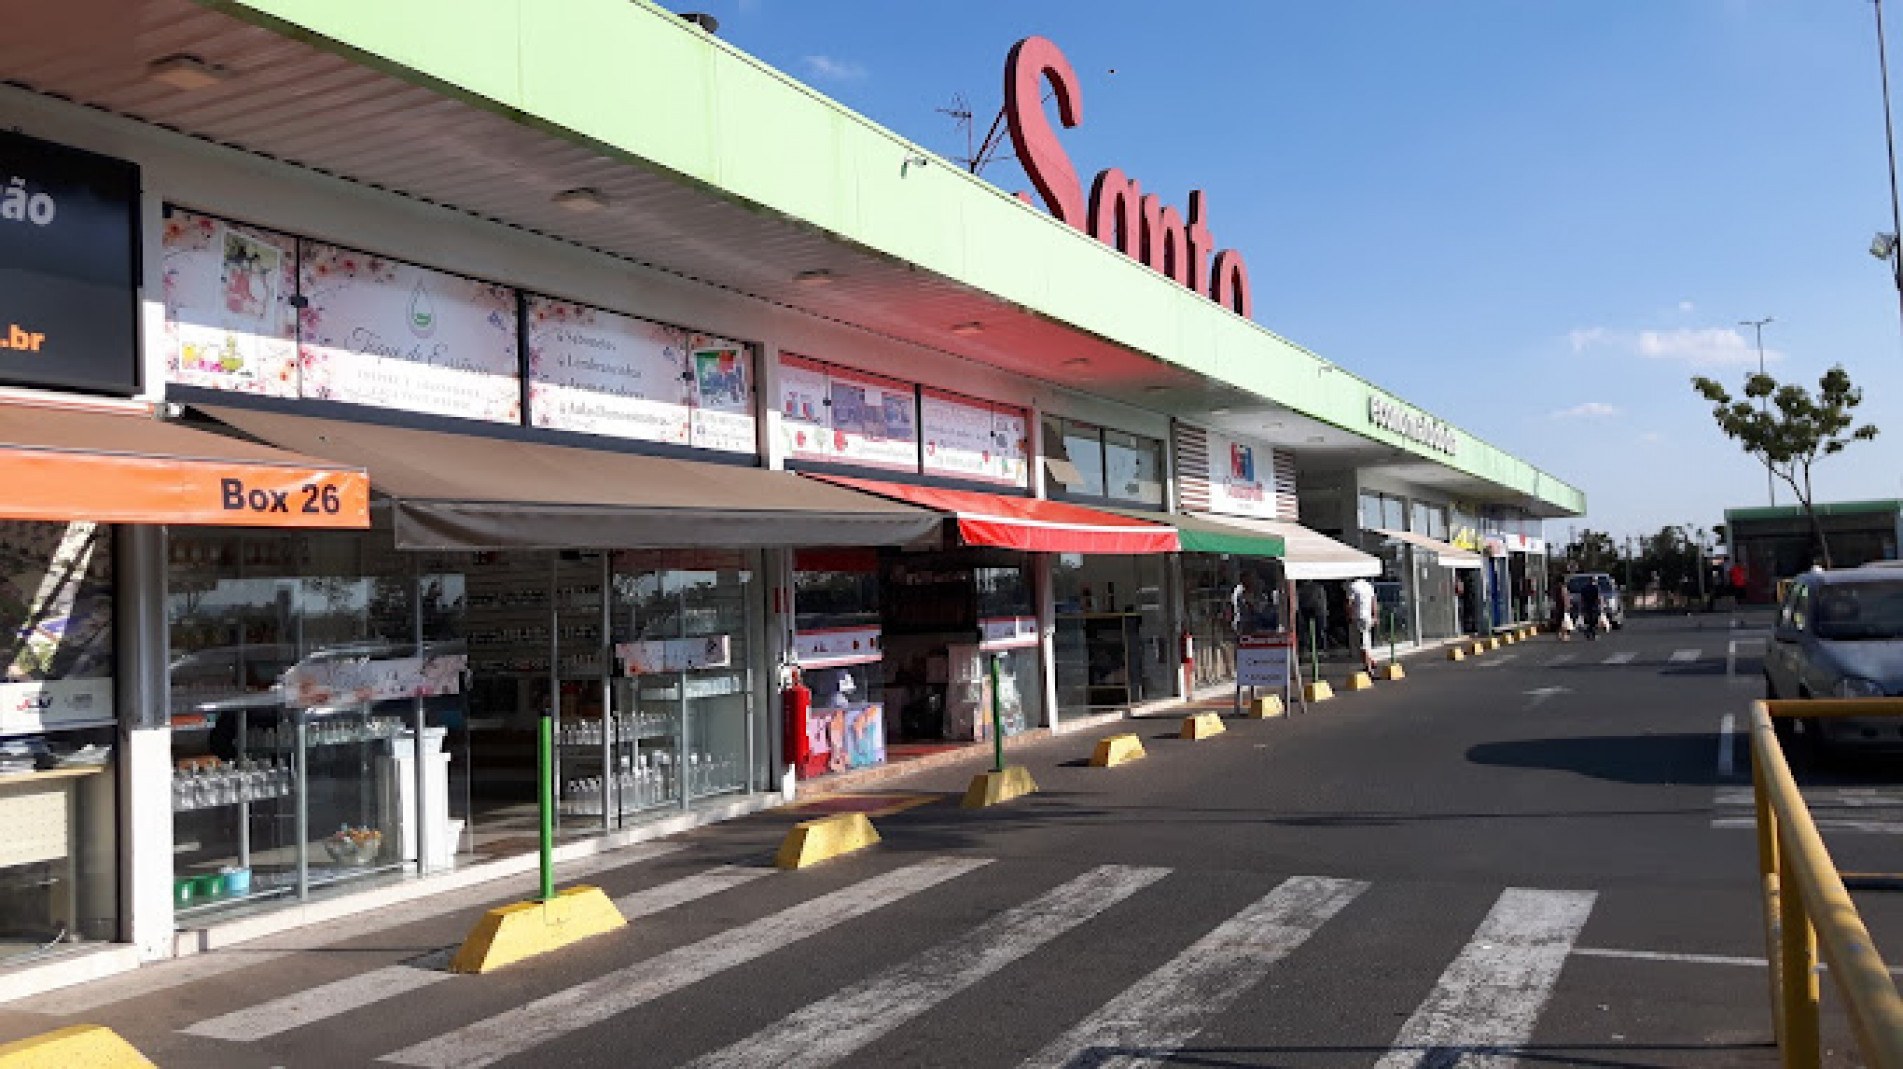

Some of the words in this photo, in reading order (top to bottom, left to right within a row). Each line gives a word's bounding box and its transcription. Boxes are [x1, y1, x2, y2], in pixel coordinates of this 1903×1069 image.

[0, 175, 56, 227] ão
[1004, 35, 1253, 319] Santo
[220, 478, 289, 513] Box
[301, 483, 340, 515] 26
